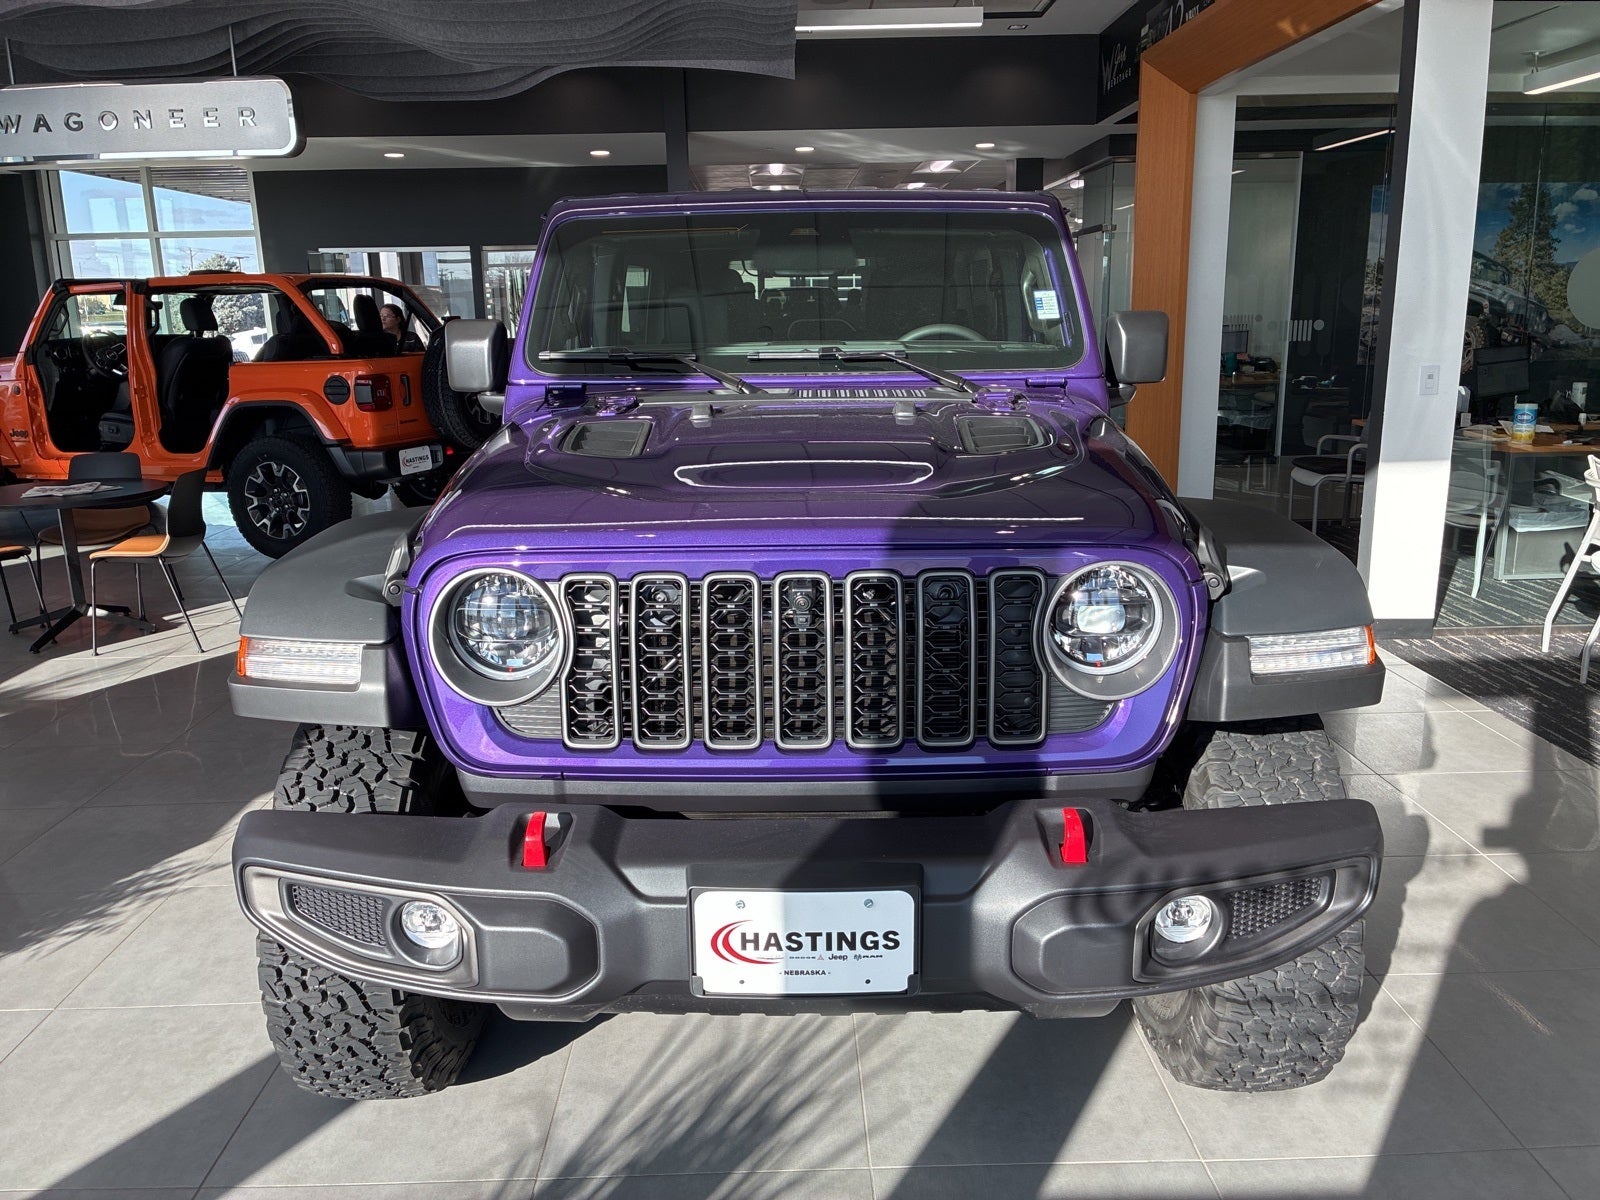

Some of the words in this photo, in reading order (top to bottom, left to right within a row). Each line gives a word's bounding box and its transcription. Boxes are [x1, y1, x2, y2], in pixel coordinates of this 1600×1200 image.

[0, 107, 257, 134] WAGONEER
[10, 428, 28, 438] Jeep
[406, 455, 429, 463] HASTINGS
[740, 930, 901, 952] HASTINGS
[828, 953, 848, 962] Jeep
